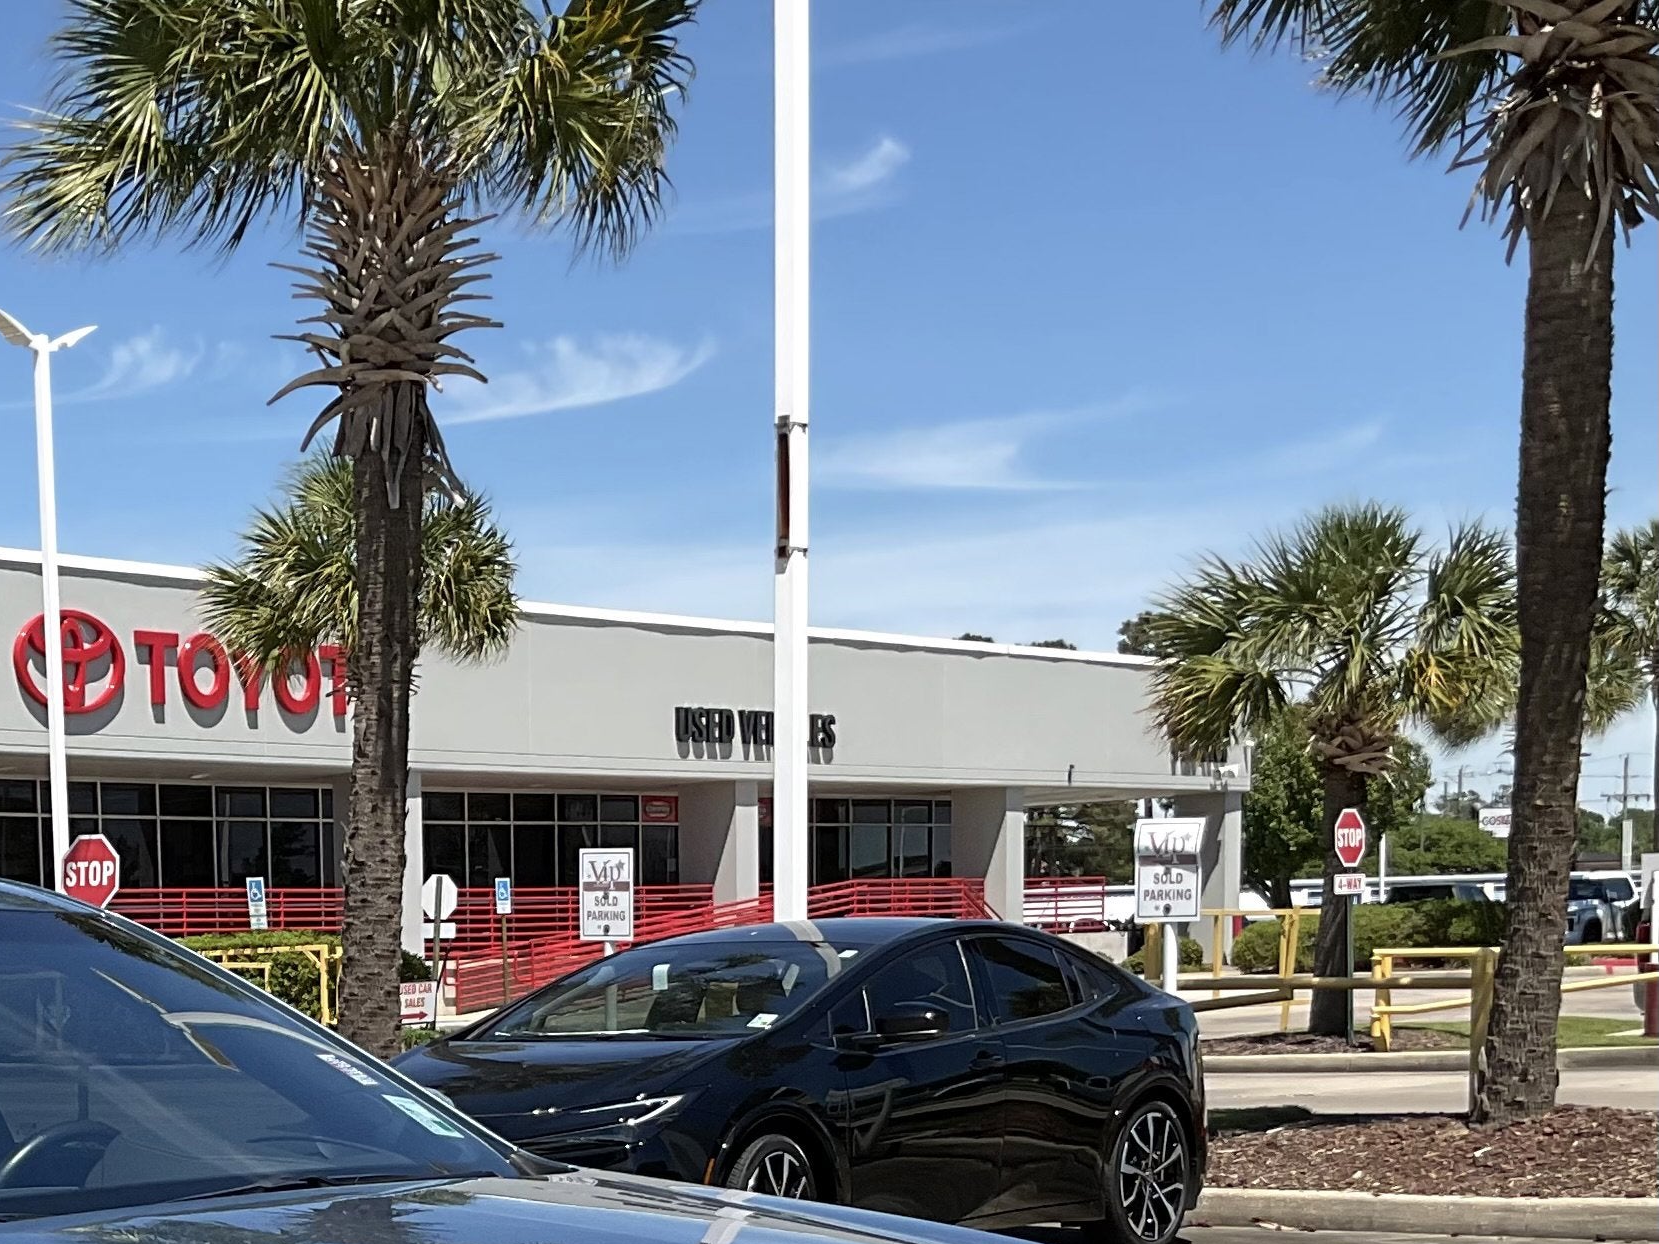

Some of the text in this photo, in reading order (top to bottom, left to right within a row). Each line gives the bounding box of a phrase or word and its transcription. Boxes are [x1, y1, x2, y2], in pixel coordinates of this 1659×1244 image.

[133, 630, 352, 716] TOYOT
[675, 706, 836, 748] USED VEES
[1337, 828, 1362, 848] STOP
[65, 860, 115, 888] STOP
[1153, 872, 1183, 885] SOLD
[1338, 878, 1362, 890] 4-WAY
[594, 895, 618, 907] SOLD
[1143, 888, 1192, 901] PARKING
[586, 910, 626, 922] PARKING
[419, 983, 432, 994] CAR
[405, 997, 425, 1008] SALES
